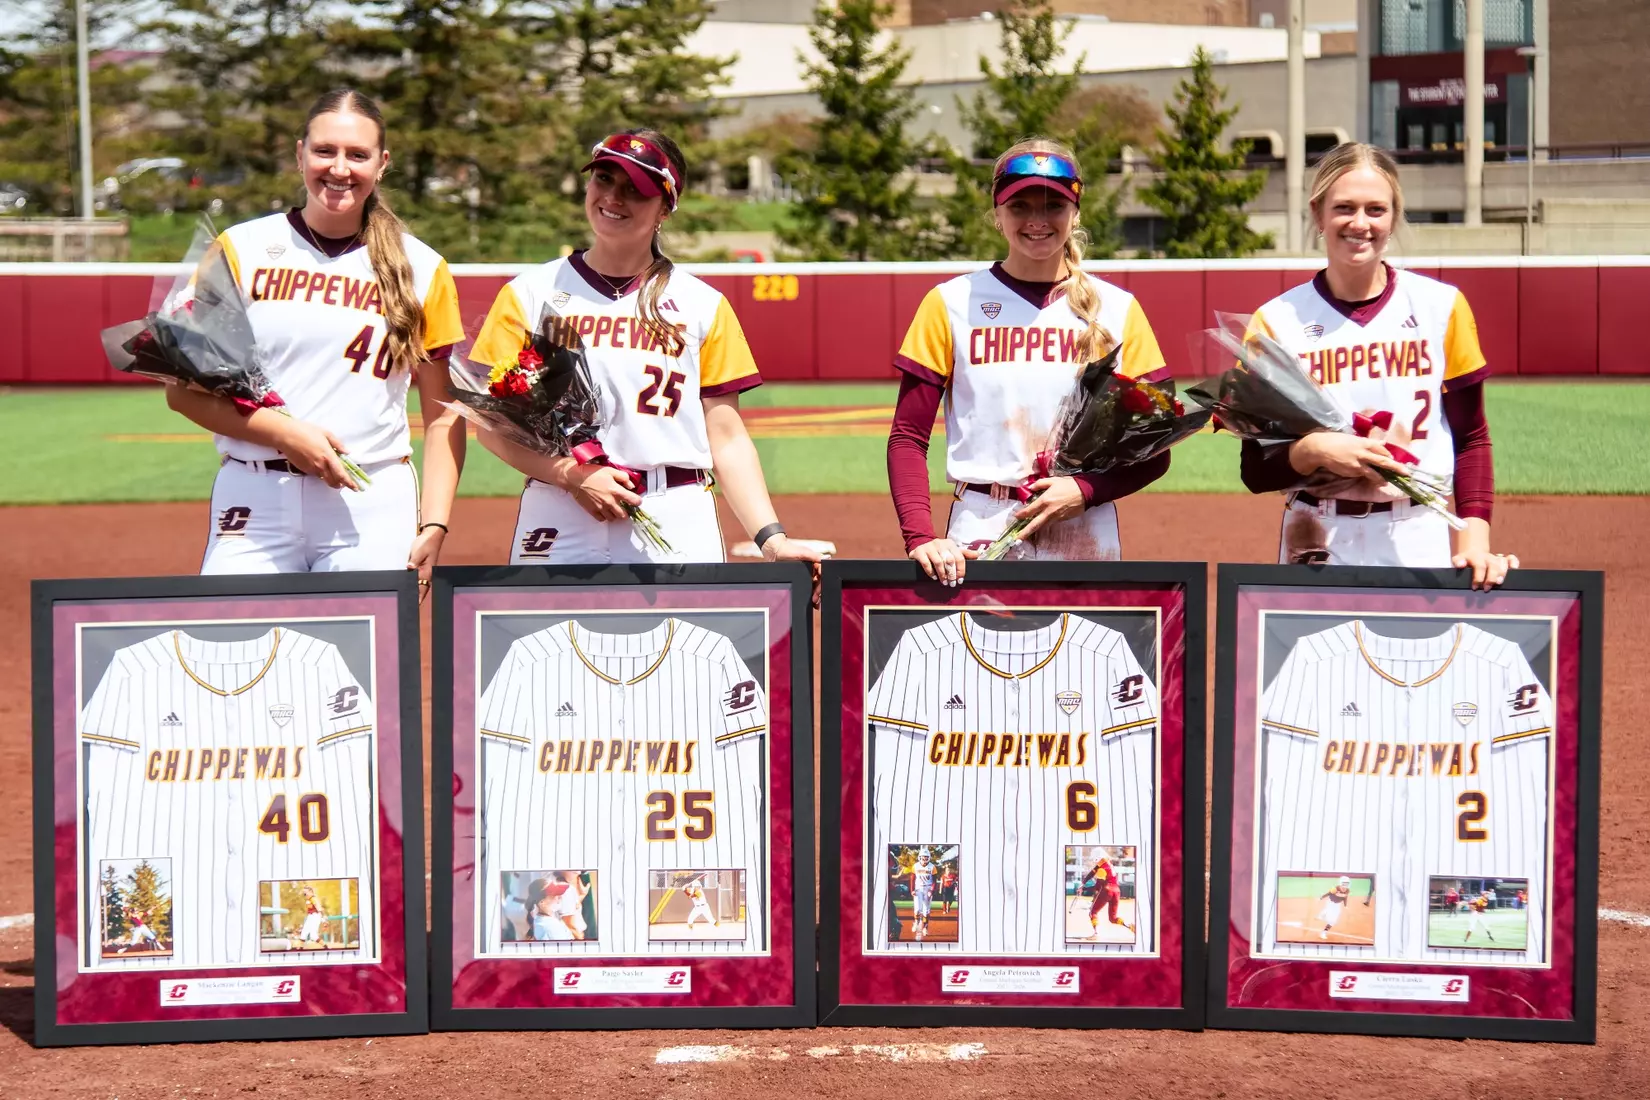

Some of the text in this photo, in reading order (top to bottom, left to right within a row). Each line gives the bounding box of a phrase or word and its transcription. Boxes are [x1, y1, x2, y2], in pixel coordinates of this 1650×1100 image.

[251, 268, 386, 316] CHIPPEWA
[753, 275, 799, 301] 220
[636, 363, 687, 418] 25
[1411, 389, 1432, 440] 2
[145, 746, 305, 782] CHIPPEWAS
[538, 739, 698, 776] CHIPPEWAS
[929, 731, 1090, 768] CHIPPEWAS
[1322, 740, 1481, 776] CHIPPEWAS
[257, 792, 331, 845] 40
[644, 789, 716, 842] 25
[1065, 780, 1099, 833] 6
[1456, 789, 1490, 842] 2
[983, 969, 1006, 977] Angela
